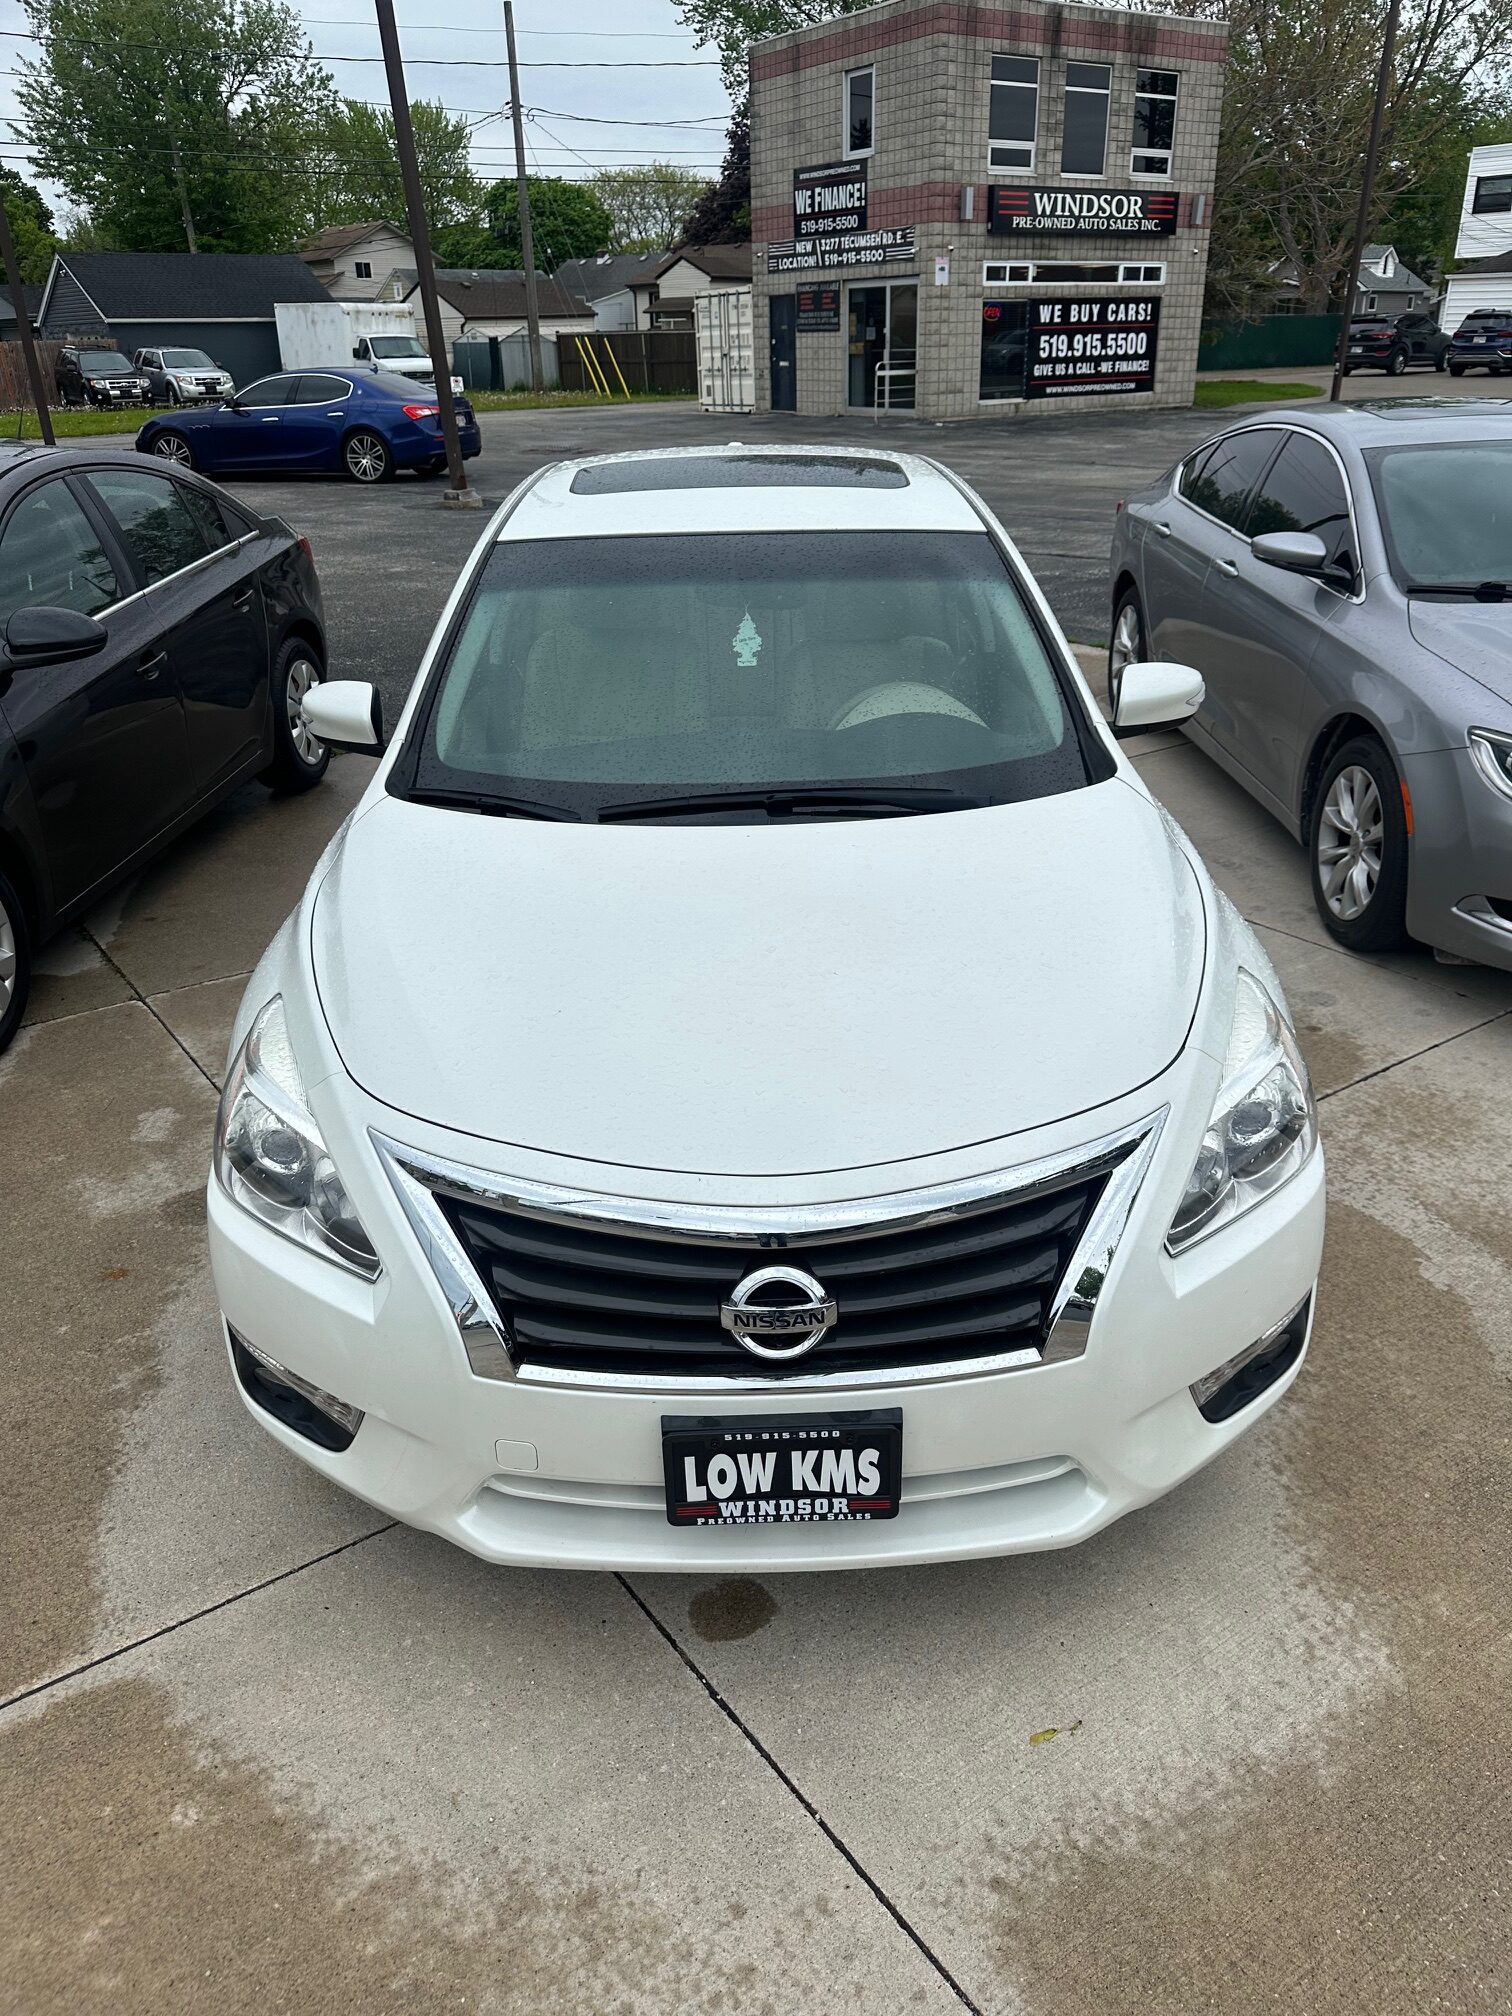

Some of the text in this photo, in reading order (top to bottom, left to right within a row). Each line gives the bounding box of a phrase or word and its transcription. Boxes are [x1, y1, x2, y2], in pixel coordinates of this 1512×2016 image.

[795, 182, 866, 215] WE FINANCE!
[1034, 192, 1143, 218] WINDSOR
[801, 215, 858, 233] 519-915-5500
[1012, 216, 1161, 231] PRE-OWNED AUTO SALES INC.
[796, 241, 813, 254] NEW
[821, 231, 904, 251] 3277 TECUMSEH RD. E.
[778, 255, 817, 270] LOCATION!
[824, 250, 884, 266] 519-915-5500
[1039, 303, 1152, 323] WE BUY CARS!
[1039, 332, 1148, 358] 519.915.5500
[1034, 364, 1053, 376] GIVE
[1055, 363, 1066, 375] US
[1067, 363, 1074, 374] A
[1076, 362, 1095, 374] CALL
[1114, 360, 1150, 372] FINANCE!
[733, 1310, 826, 1330] NISSAN
[724, 1430, 840, 1441] 519-915-5500
[684, 1448, 880, 1502] LOW KMS
[718, 1498, 849, 1517] WINDSOR
[697, 1512, 872, 1526] PREOWNED AUTO SALES
